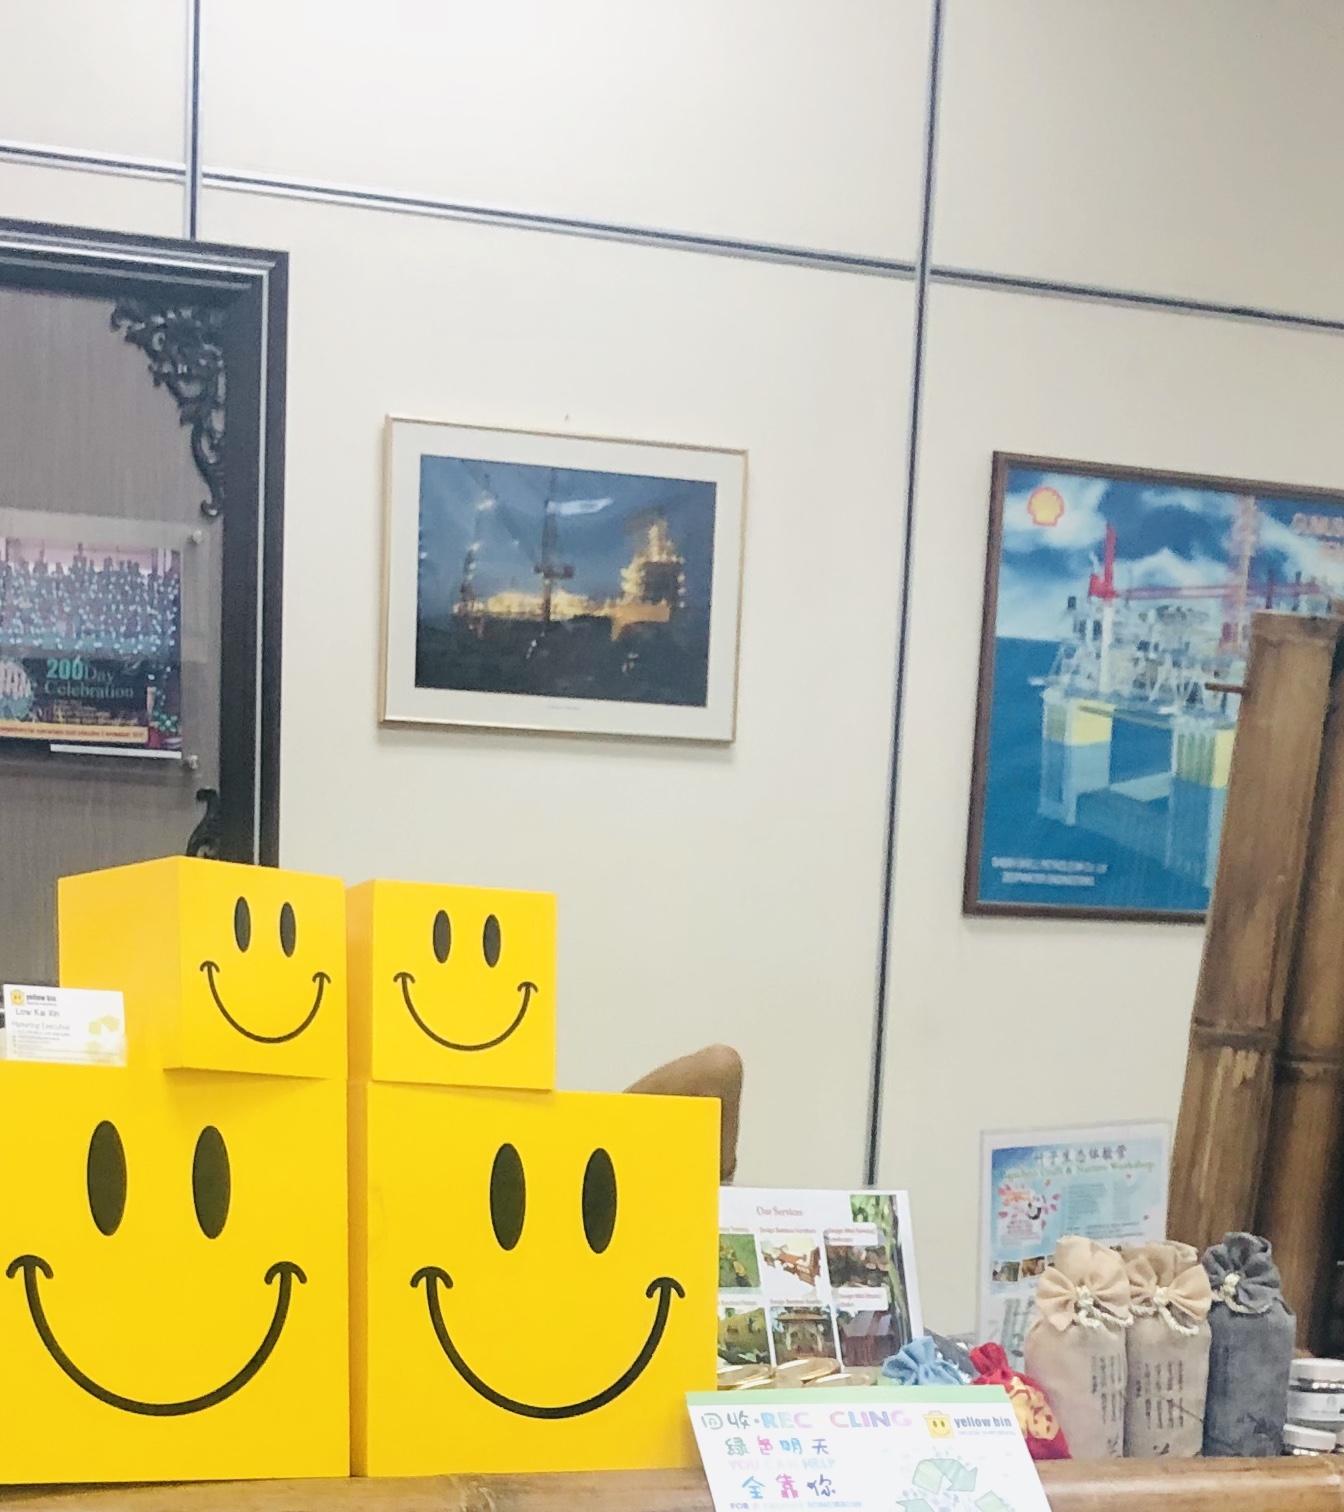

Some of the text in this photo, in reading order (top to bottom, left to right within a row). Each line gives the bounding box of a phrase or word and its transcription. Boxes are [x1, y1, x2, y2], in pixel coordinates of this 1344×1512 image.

[44, 681, 134, 699] Celebration
[773, 1206, 803, 1217] Services
[760, 1409, 912, 1430] RECCLING
[954, 1416, 1012, 1428] yellow bin
